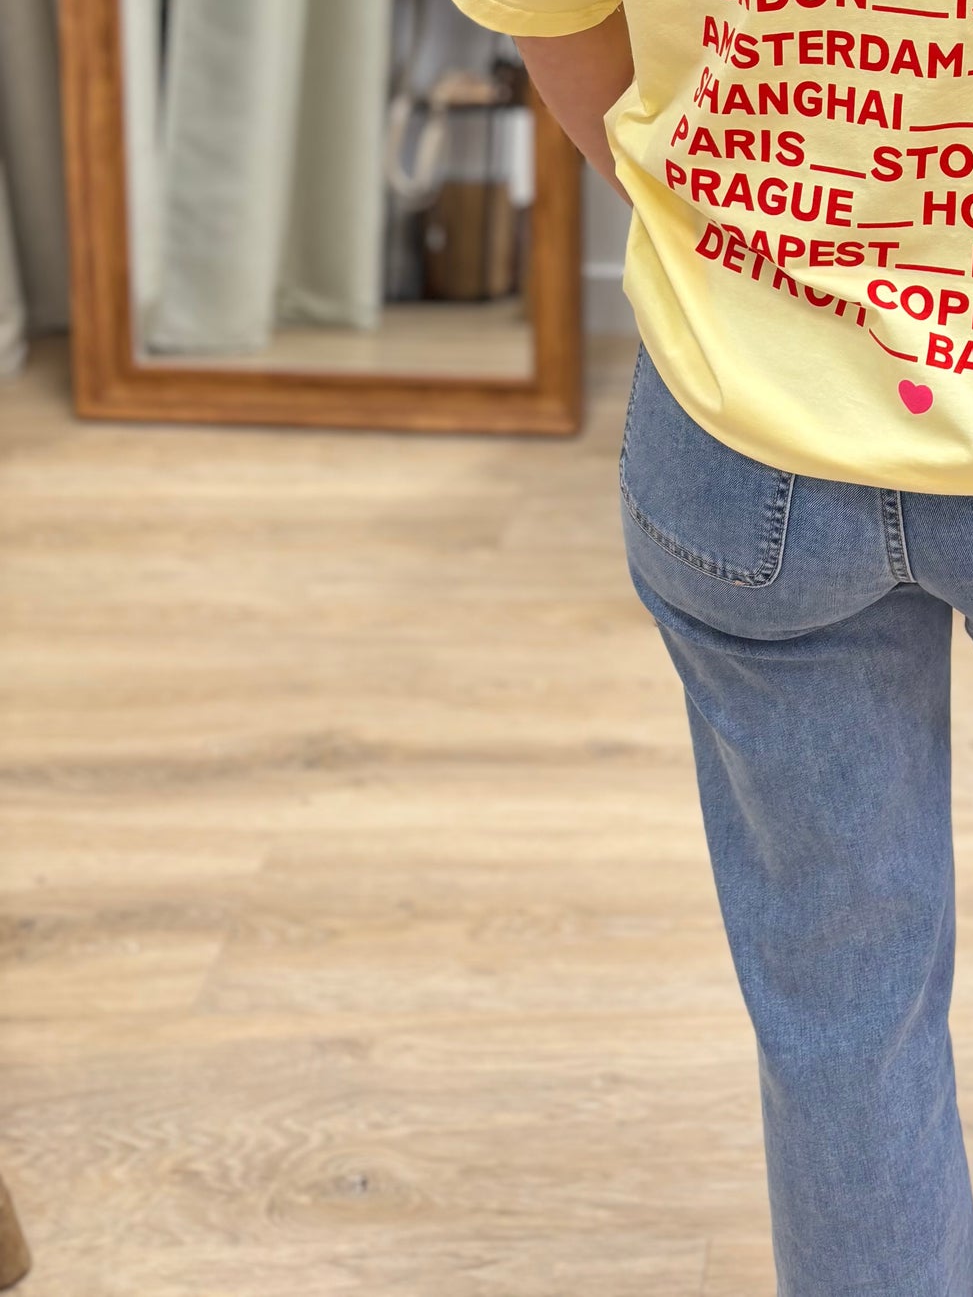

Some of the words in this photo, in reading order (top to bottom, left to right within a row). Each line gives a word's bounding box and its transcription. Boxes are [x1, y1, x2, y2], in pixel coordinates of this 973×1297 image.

[701, 14, 964, 79] AMSTERDAM
[693, 65, 904, 131] SHANGHAI
[670, 114, 805, 168] PARIS
[664, 158, 854, 228] PRAGUE
